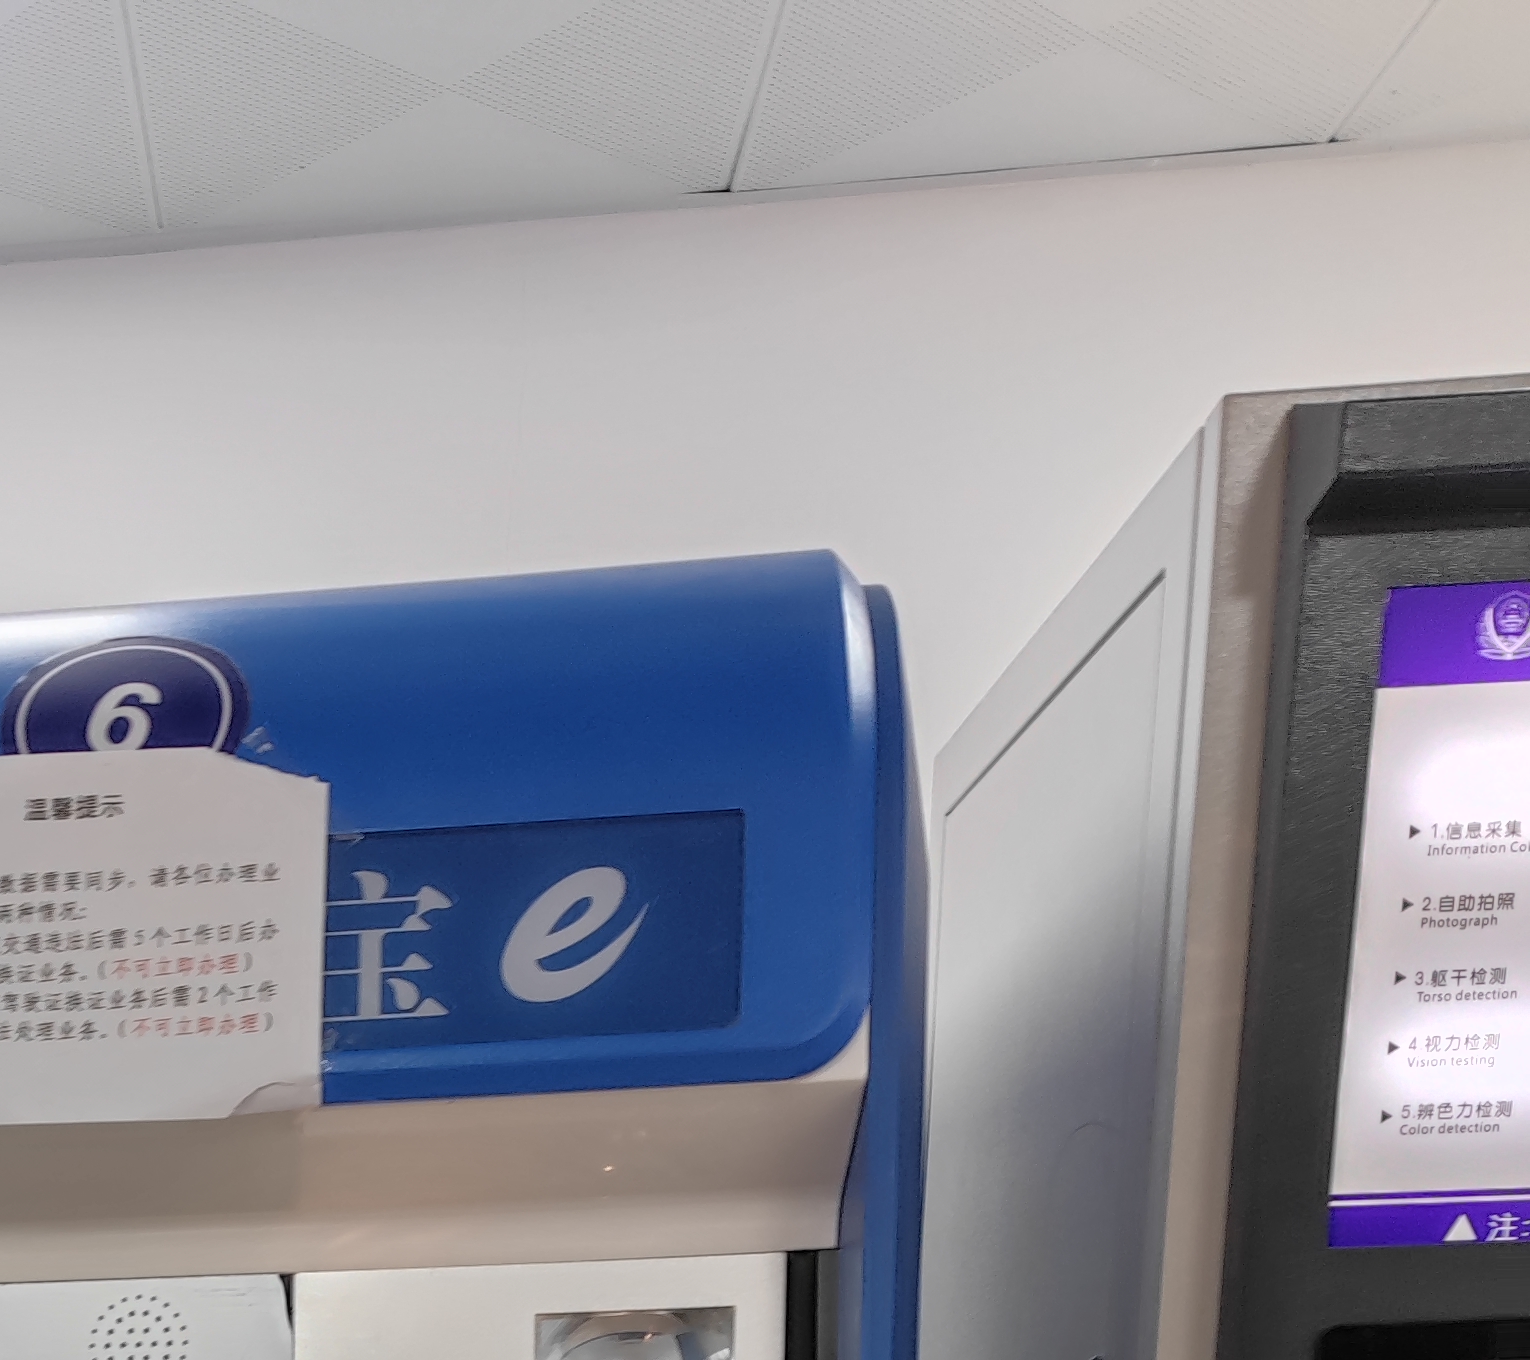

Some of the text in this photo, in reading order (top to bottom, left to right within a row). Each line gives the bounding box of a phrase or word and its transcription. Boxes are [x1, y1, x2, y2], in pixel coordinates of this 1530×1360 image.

[84, 681, 164, 751] 6
[23, 794, 125, 822] 温馨提示
[1431, 820, 1522, 841] 1.信息采集
[1427, 843, 1506, 857] Information
[1421, 893, 1515, 912] 2.自助拍照
[1420, 914, 1499, 930] Photograph
[1414, 967, 1507, 988] 3.躯干检测
[1417, 989, 1518, 1003] Torso detection
[1407, 1055, 1495, 1068] Vision testing
[1401, 1101, 1514, 1120] 5.辨色力检测
[1400, 1121, 1500, 1136] Color detection
[1484, 1211, 1530, 1242] 注
